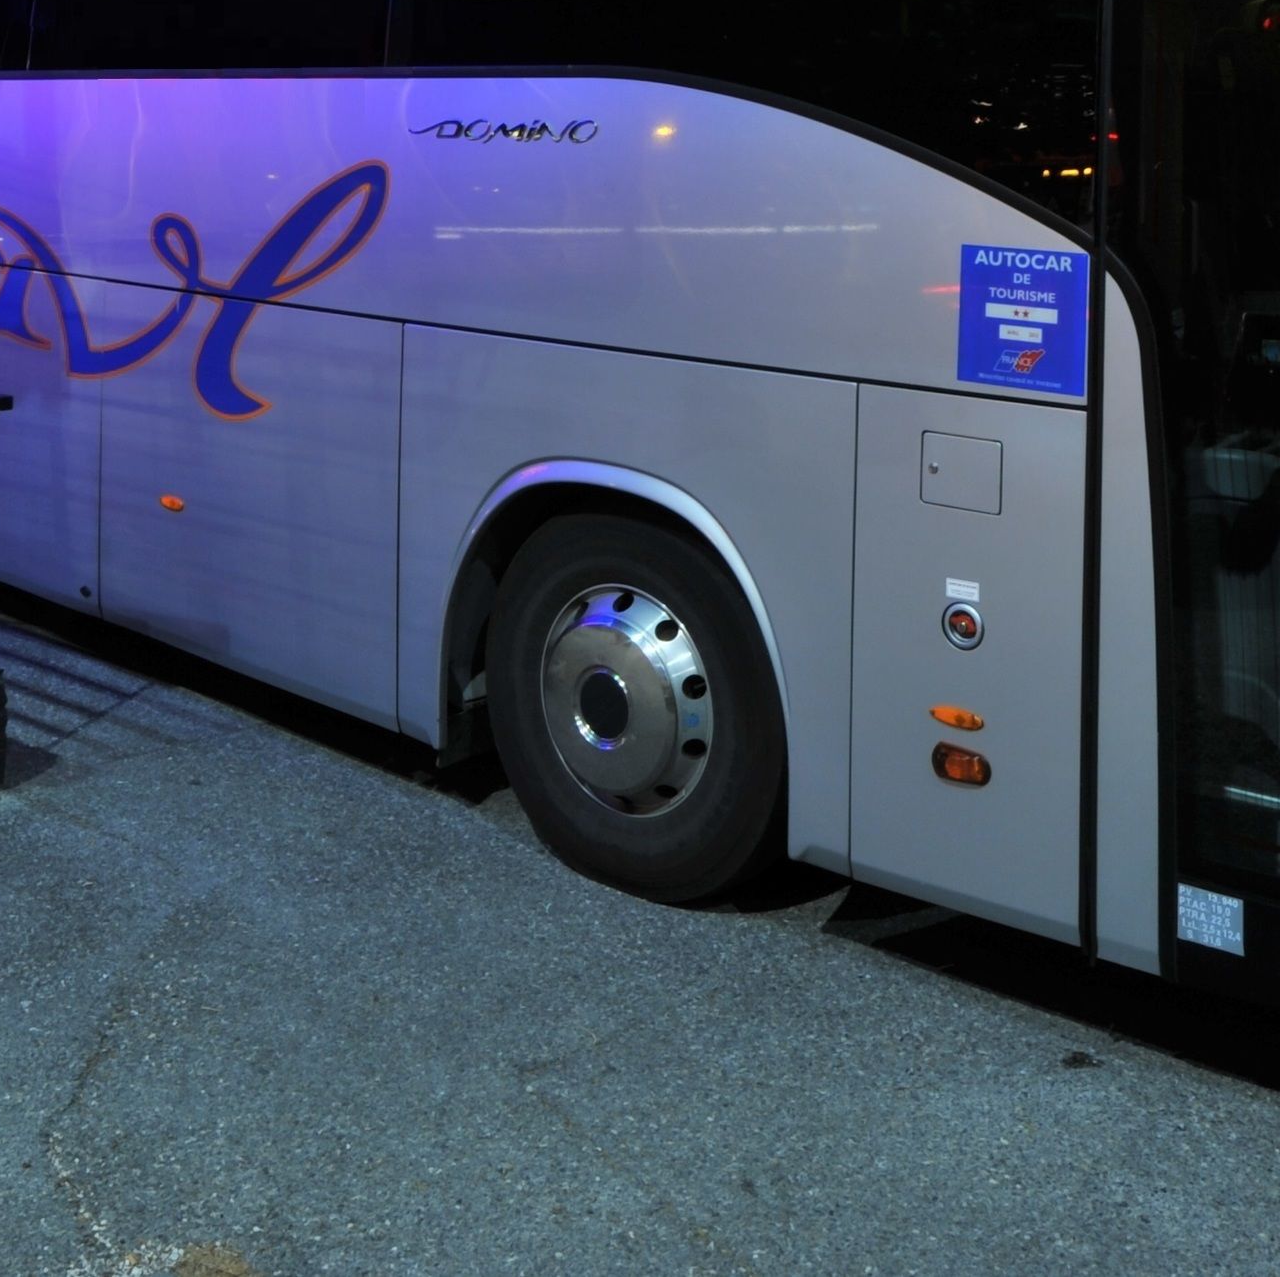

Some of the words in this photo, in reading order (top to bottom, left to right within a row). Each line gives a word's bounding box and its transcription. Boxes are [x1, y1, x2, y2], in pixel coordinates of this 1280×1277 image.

[975, 249, 1072, 272] AUTOCAR
[1013, 272, 1032, 285] DE
[989, 286, 1056, 304] TOURISME
